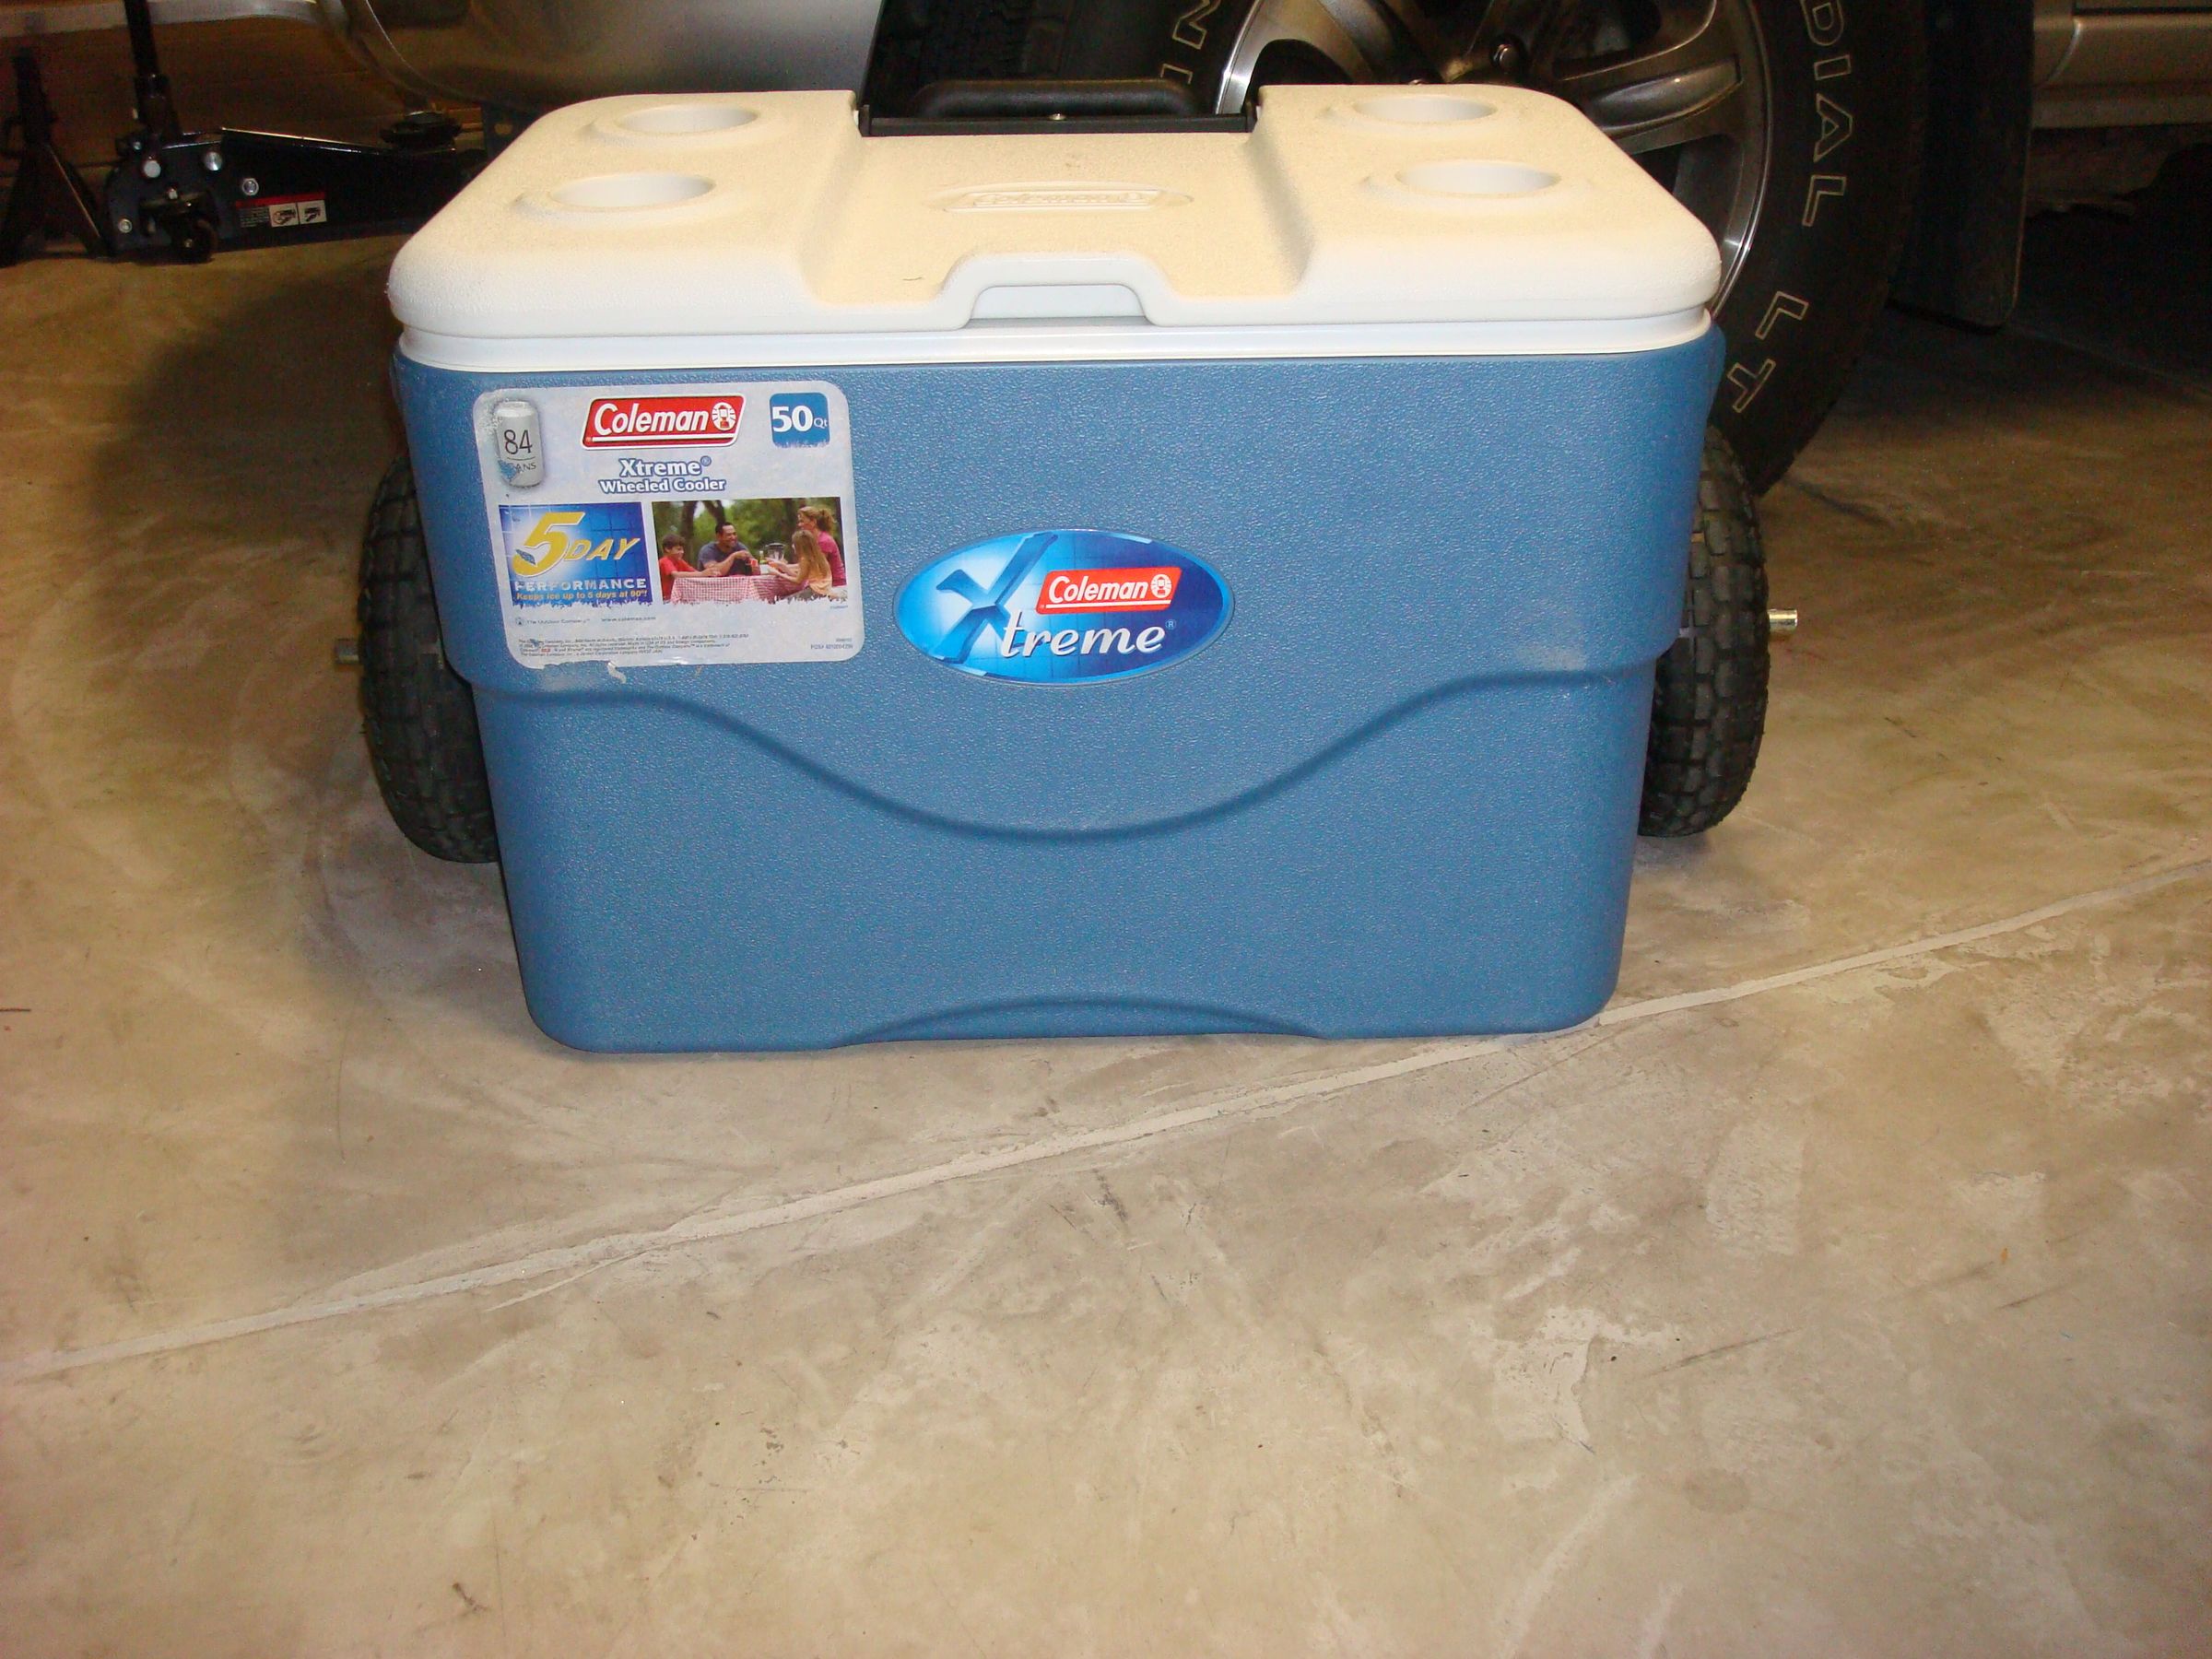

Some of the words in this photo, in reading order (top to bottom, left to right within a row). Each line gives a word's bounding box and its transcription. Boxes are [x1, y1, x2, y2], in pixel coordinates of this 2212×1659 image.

[594, 403, 709, 435] Coleman
[504, 429, 533, 455] 84
[512, 461, 536, 475] ANS
[599, 478, 670, 494] Wheeled
[672, 477, 726, 492] Cooler
[512, 512, 586, 578] 5
[563, 537, 641, 561] DAY
[514, 578, 647, 591] PERFORMANCE
[1048, 574, 1147, 605] Coleman
[562, 593, 574, 601] up
[595, 590, 617, 600] days
[618, 590, 628, 598] at
